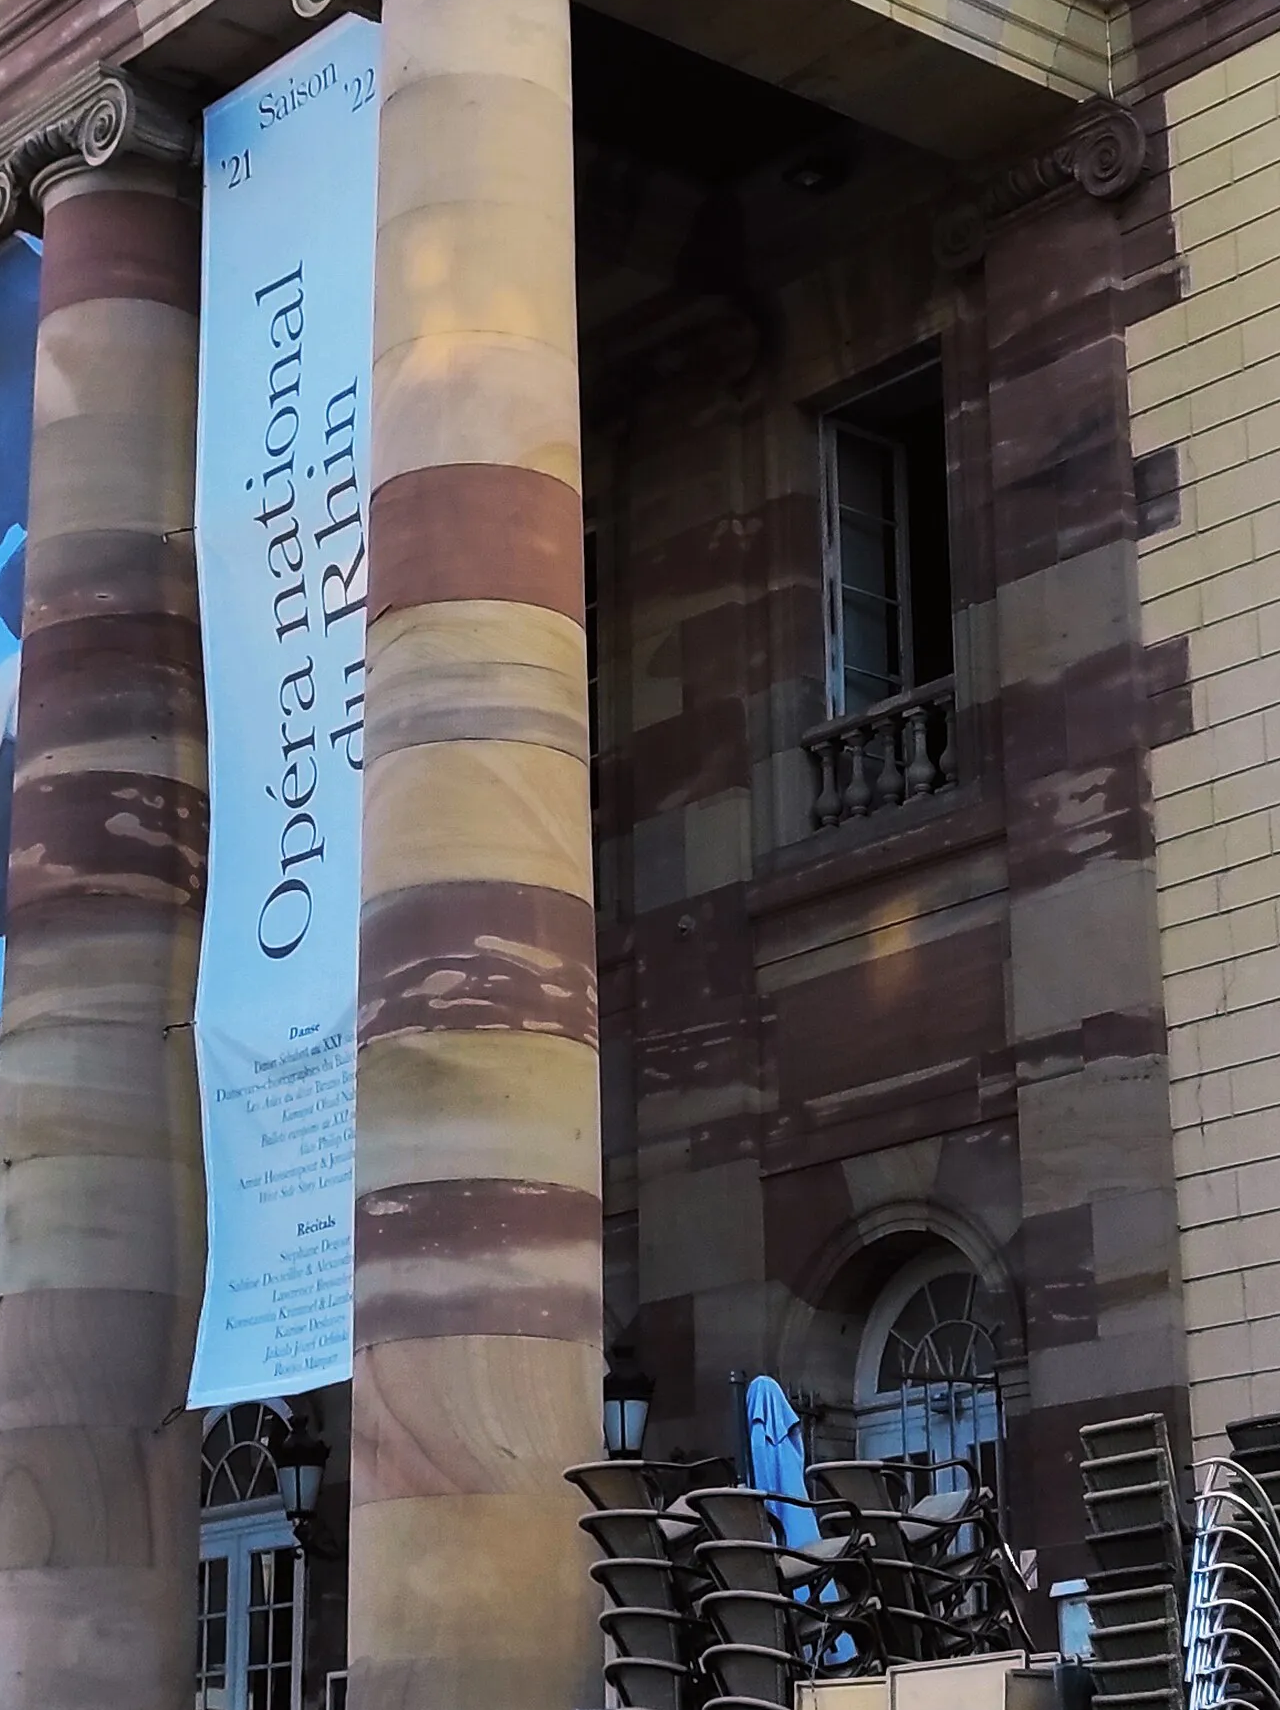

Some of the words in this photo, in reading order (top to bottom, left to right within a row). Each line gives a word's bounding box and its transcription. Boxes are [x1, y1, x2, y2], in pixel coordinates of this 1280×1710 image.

[258, 62, 338, 130] Saison
[344, 68, 376, 113] '22
[221, 149, 252, 189] '21
[245, 258, 311, 644] national
[306, 375, 368, 638] Rhin
[257, 654, 326, 961] Opéra
[288, 1023, 320, 1040] Danse
